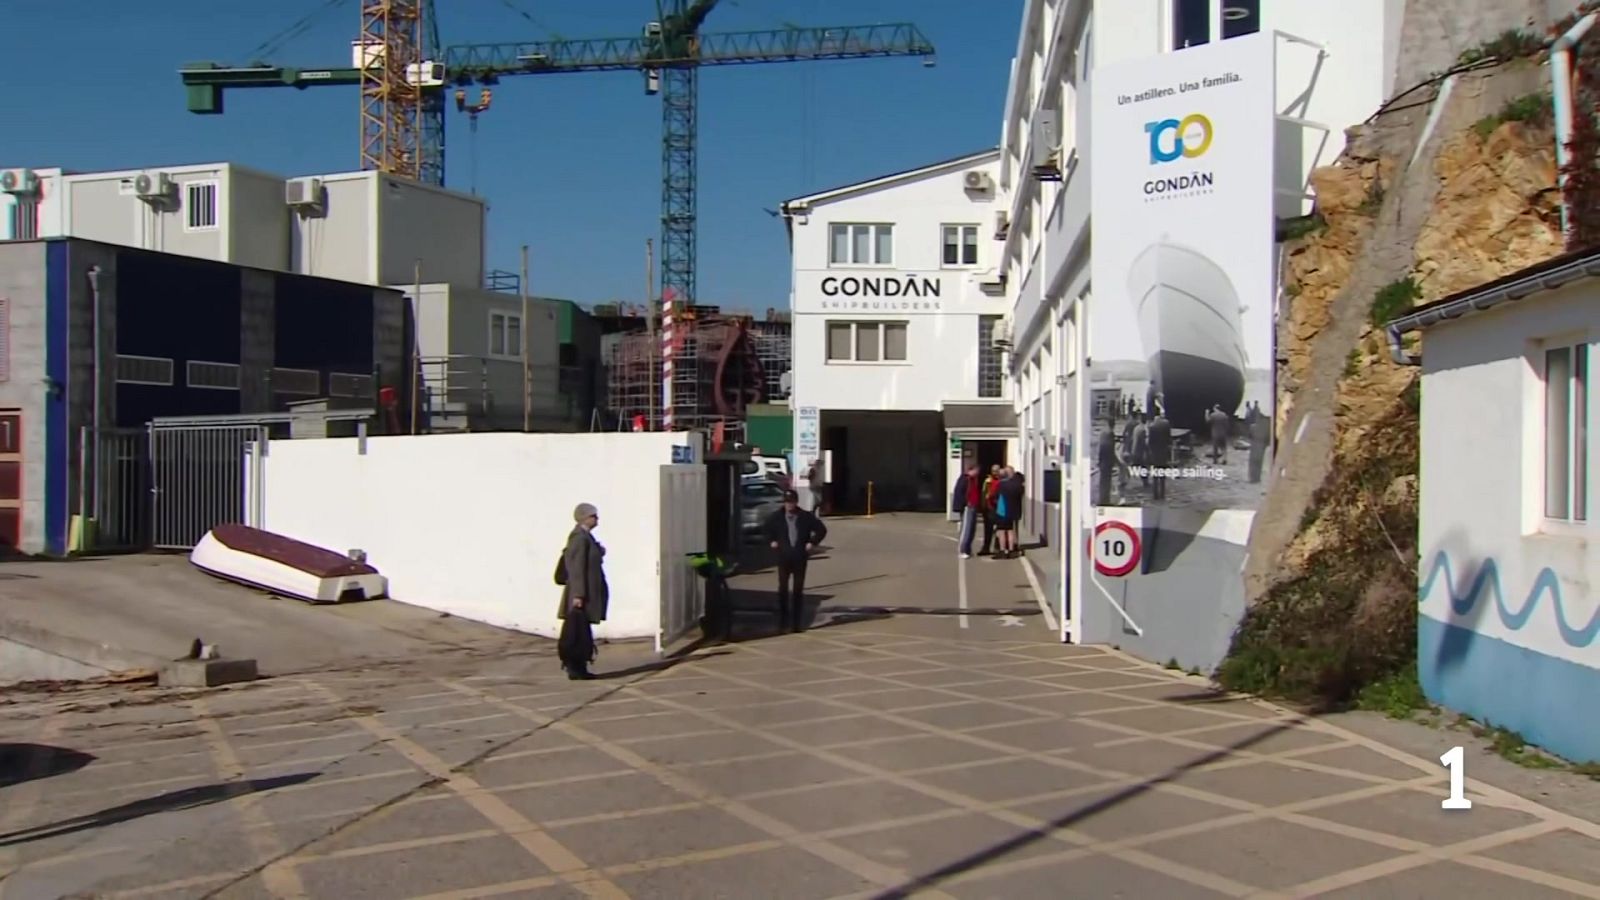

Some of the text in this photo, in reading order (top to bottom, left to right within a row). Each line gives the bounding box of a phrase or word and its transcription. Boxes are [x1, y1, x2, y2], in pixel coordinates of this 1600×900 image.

[1117, 72, 1243, 106] Un astillero. Una familia.
[1128, 465, 1228, 481] We keep sailing.
[1103, 540, 1126, 557] 10
